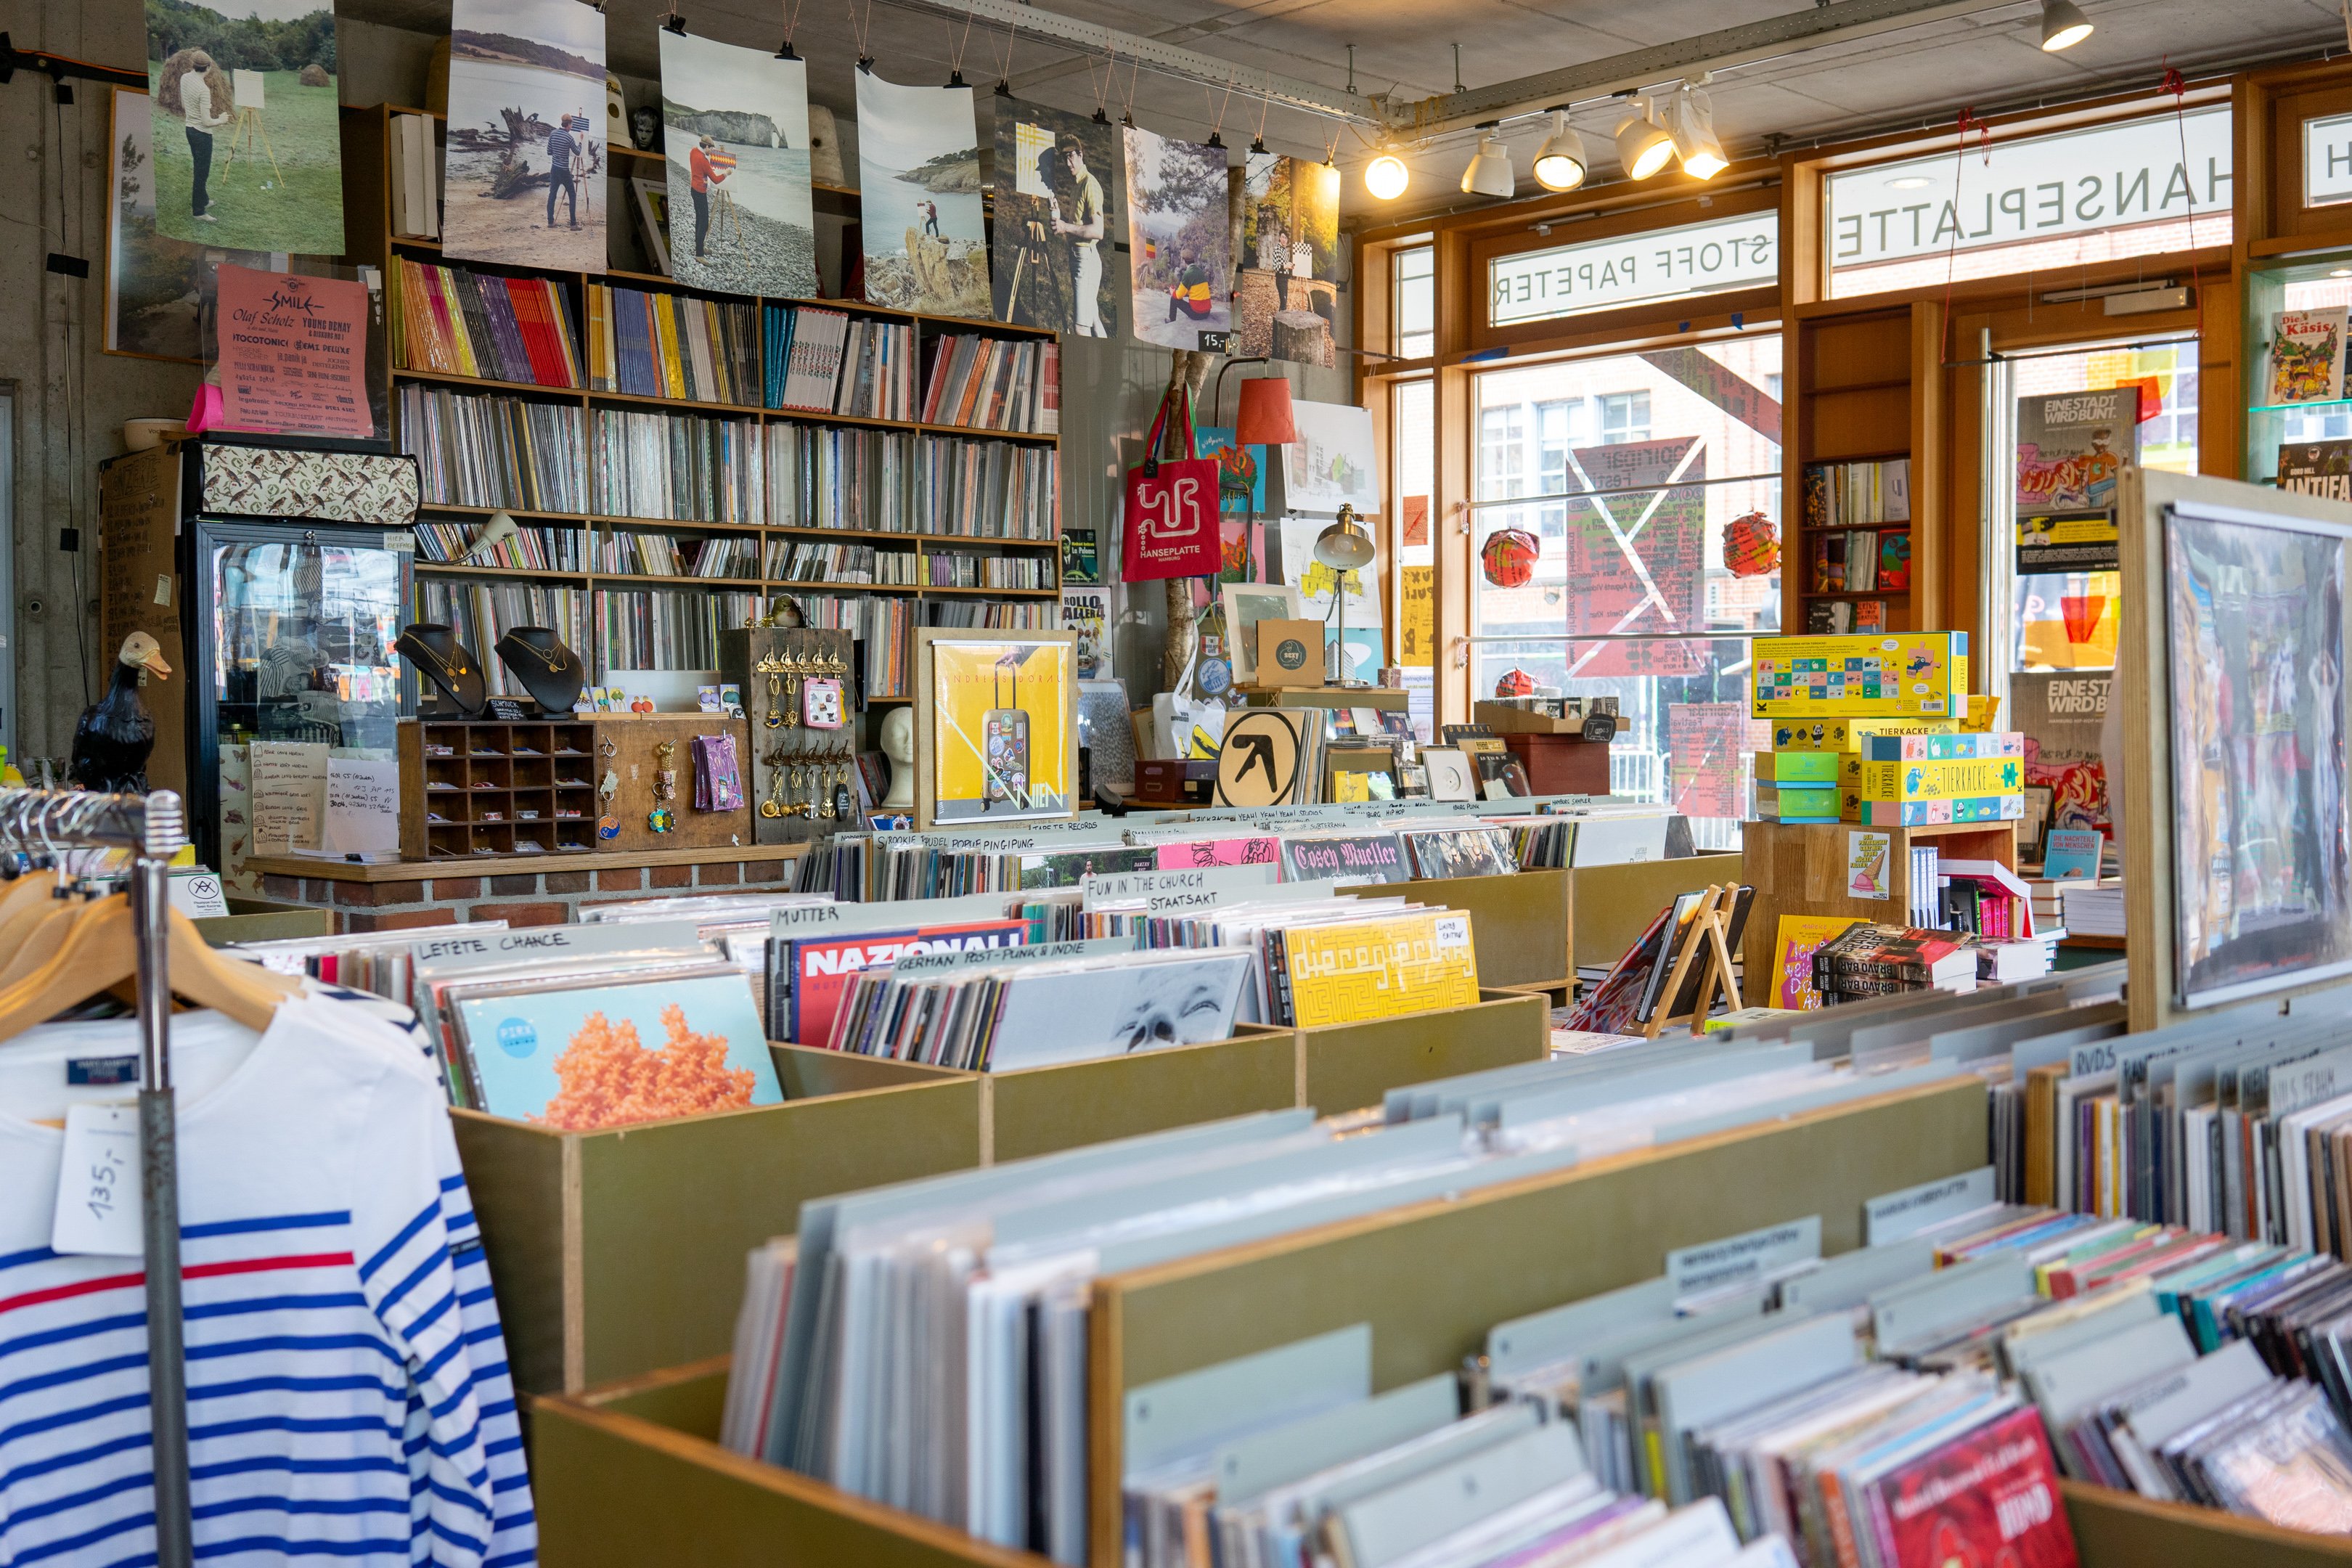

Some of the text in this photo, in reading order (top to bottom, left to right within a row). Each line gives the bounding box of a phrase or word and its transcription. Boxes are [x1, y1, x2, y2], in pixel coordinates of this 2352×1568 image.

[233, 309, 295, 327] Olaf Scholz
[303, 317, 327, 330] YOUNG
[2282, 316, 2300, 324] Die
[2287, 322, 2330, 336] Käsis
[1204, 334, 1225, 348] 15,-
[2285, 475, 2350, 502] ANTIFA
[1140, 545, 1200, 558] HANSEPLATTE
[1063, 595, 1101, 608] ROLLO
[1881, 764, 1895, 799] TIERKACKE
[1942, 766, 1987, 793] TIERKACKE
[1238, 812, 1257, 821] YEAH!
[1069, 822, 1098, 830] RECORDS
[984, 838, 1034, 850] PINGIPUNG
[1294, 841, 1397, 873] Cosey Mueller
[1088, 872, 1204, 897] FUN IN THE CHURCH
[1151, 891, 1218, 912] STAATSAKT
[777, 907, 839, 926] MUTTER
[418, 933, 571, 960] LETZTE CHANCE
[1838, 929, 1878, 952] BRAVO
[1861, 935, 1887, 950] BAR
[898, 955, 956, 972] GERMAN
[965, 945, 1036, 964] POST-PUNK
[1050, 942, 1084, 957] INDIE
[1840, 961, 1893, 974] BRAVO BAR
[1841, 981, 1894, 993] BRAVO BAR
